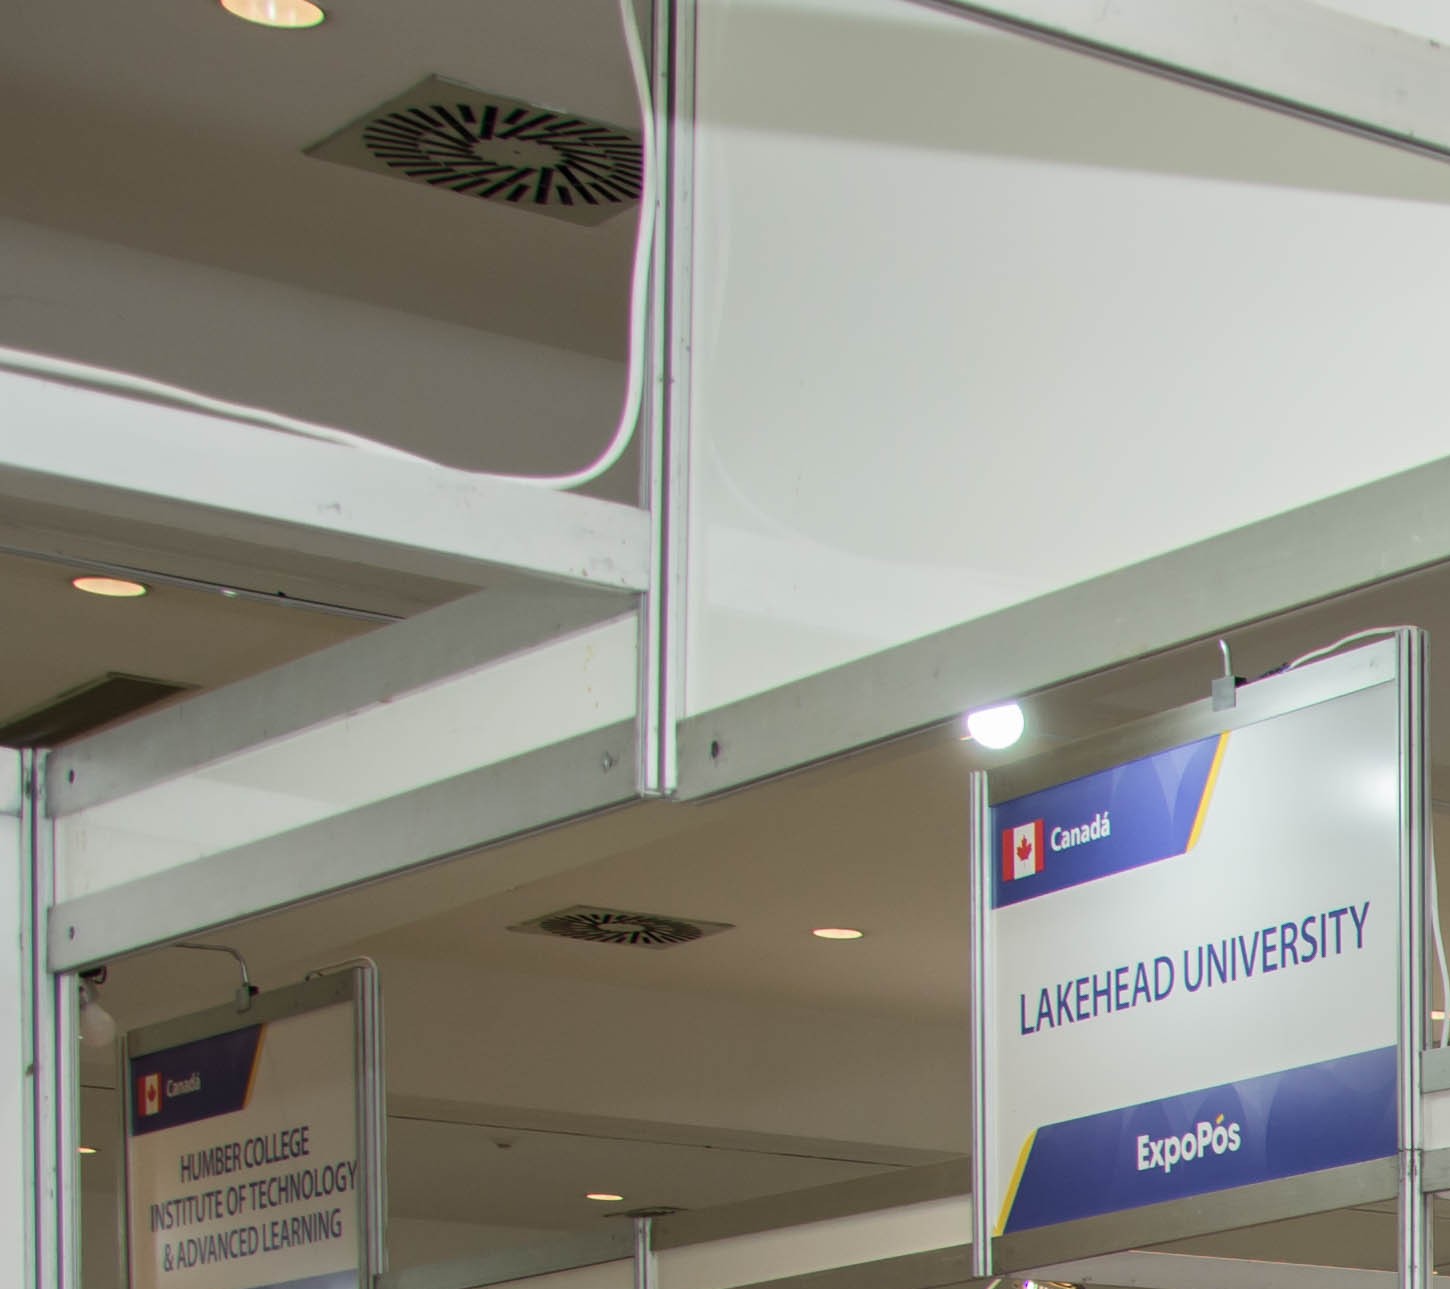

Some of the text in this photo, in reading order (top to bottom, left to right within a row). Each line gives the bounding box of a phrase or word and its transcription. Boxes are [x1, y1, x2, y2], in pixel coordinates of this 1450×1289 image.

[1051, 811, 1111, 853] Canadá
[1019, 901, 1371, 1036] LAKEHEAD UNIVERSITY
[180, 1126, 310, 1184] HUMBER COLLEGE
[1137, 1113, 1241, 1173] ExpoPós
[150, 1160, 358, 1233] INSTITUTE OF TECHNOLOGY
[163, 1208, 342, 1272] & ADVANCED LEARNING
